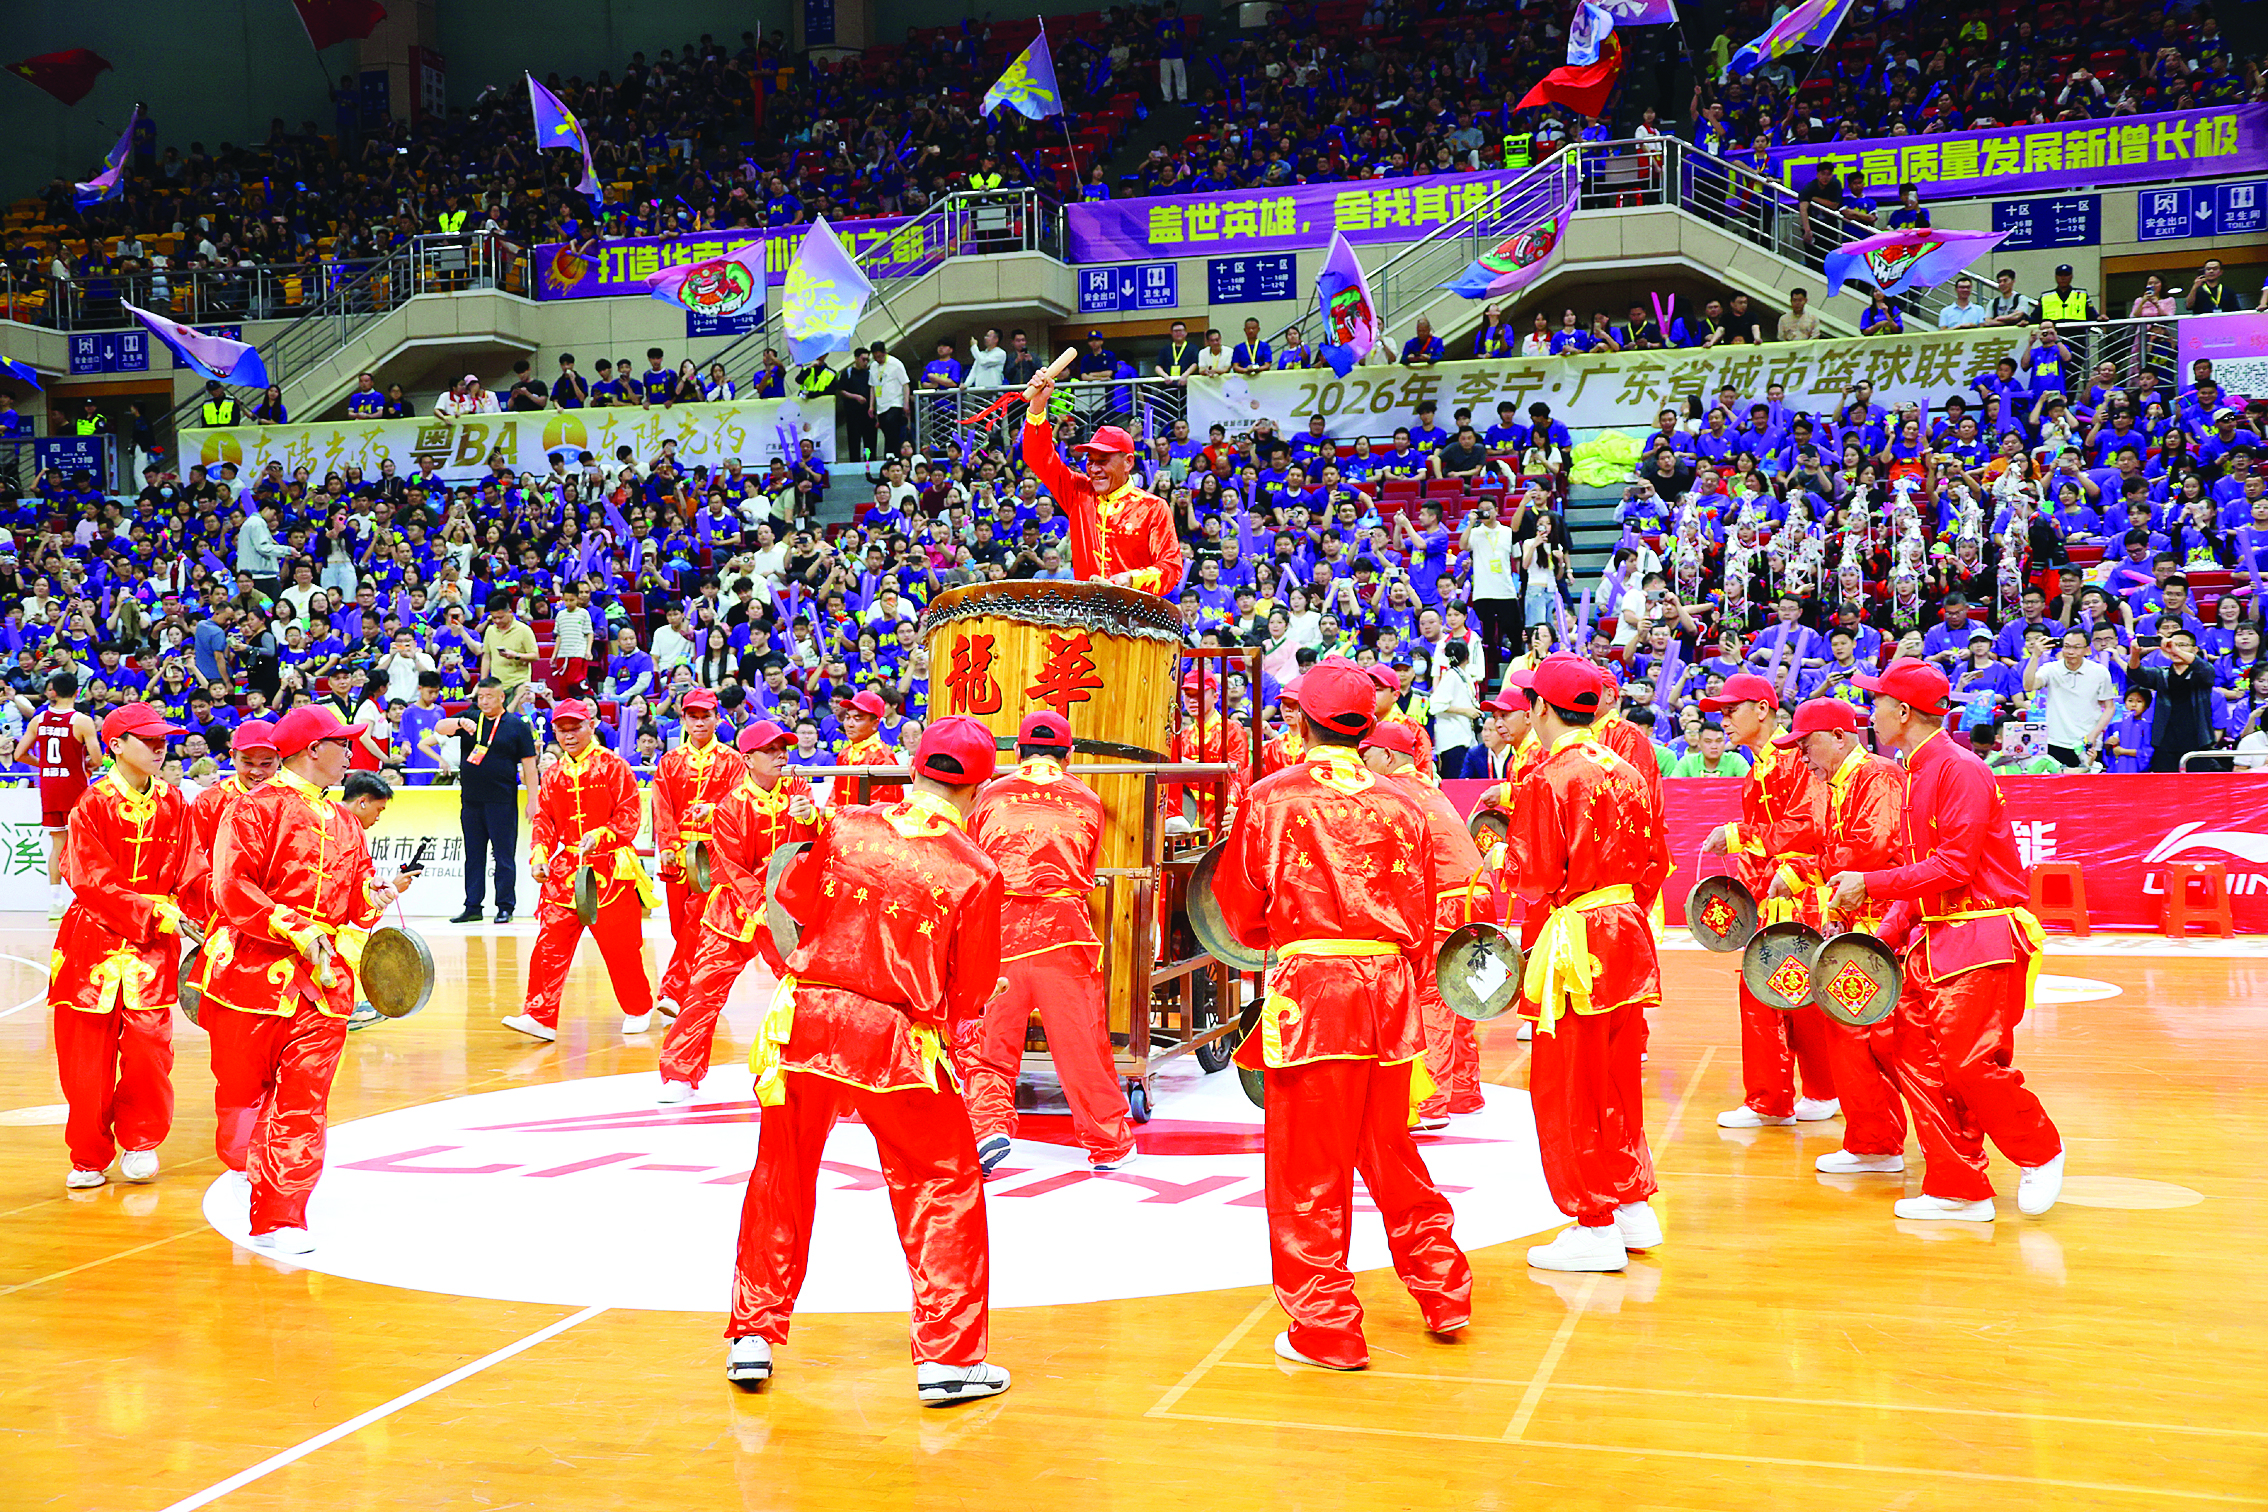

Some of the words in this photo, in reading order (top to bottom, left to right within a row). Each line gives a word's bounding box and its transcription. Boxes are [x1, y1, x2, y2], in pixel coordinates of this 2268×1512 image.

[1783, 114, 2238, 189] 广东高质量发展新增长极
[2005, 204, 2030, 216] 十区
[2051, 200, 2089, 213] 十一区
[2145, 216, 2187, 228] 安全出口
[2224, 210, 2261, 222] 卫生间
[2227, 221, 2256, 229] TOILET
[1084, 292, 1115, 302] 安全出口
[1290, 373, 1442, 417] 2026年
[408, 421, 517, 471] 粤BA
[46, 737, 62, 764] 0
[1, 821, 47, 876] 溪
[2010, 821, 2057, 869] 能
[374, 867, 393, 877] ITY
